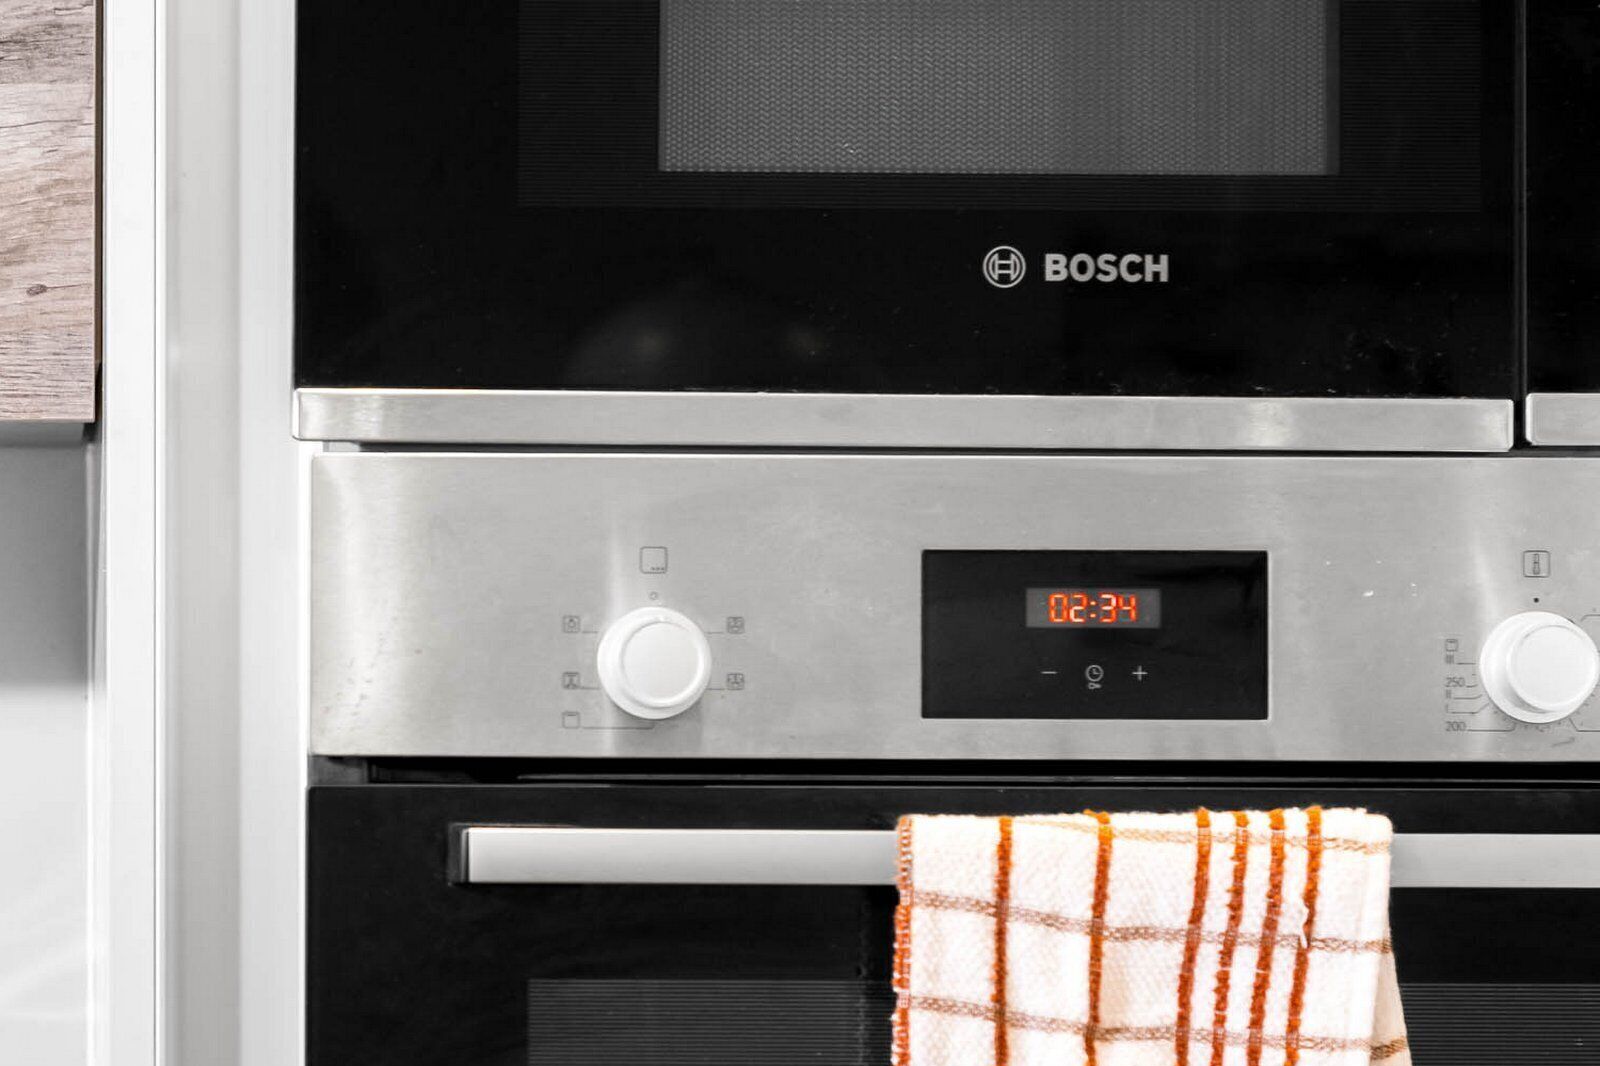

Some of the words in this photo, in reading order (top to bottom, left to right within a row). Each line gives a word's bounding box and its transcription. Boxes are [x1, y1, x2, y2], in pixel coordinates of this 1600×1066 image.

[1044, 253, 1169, 282] BOSCH
[1048, 592, 1137, 623] 02:34
[1445, 720, 1467, 732] 200
